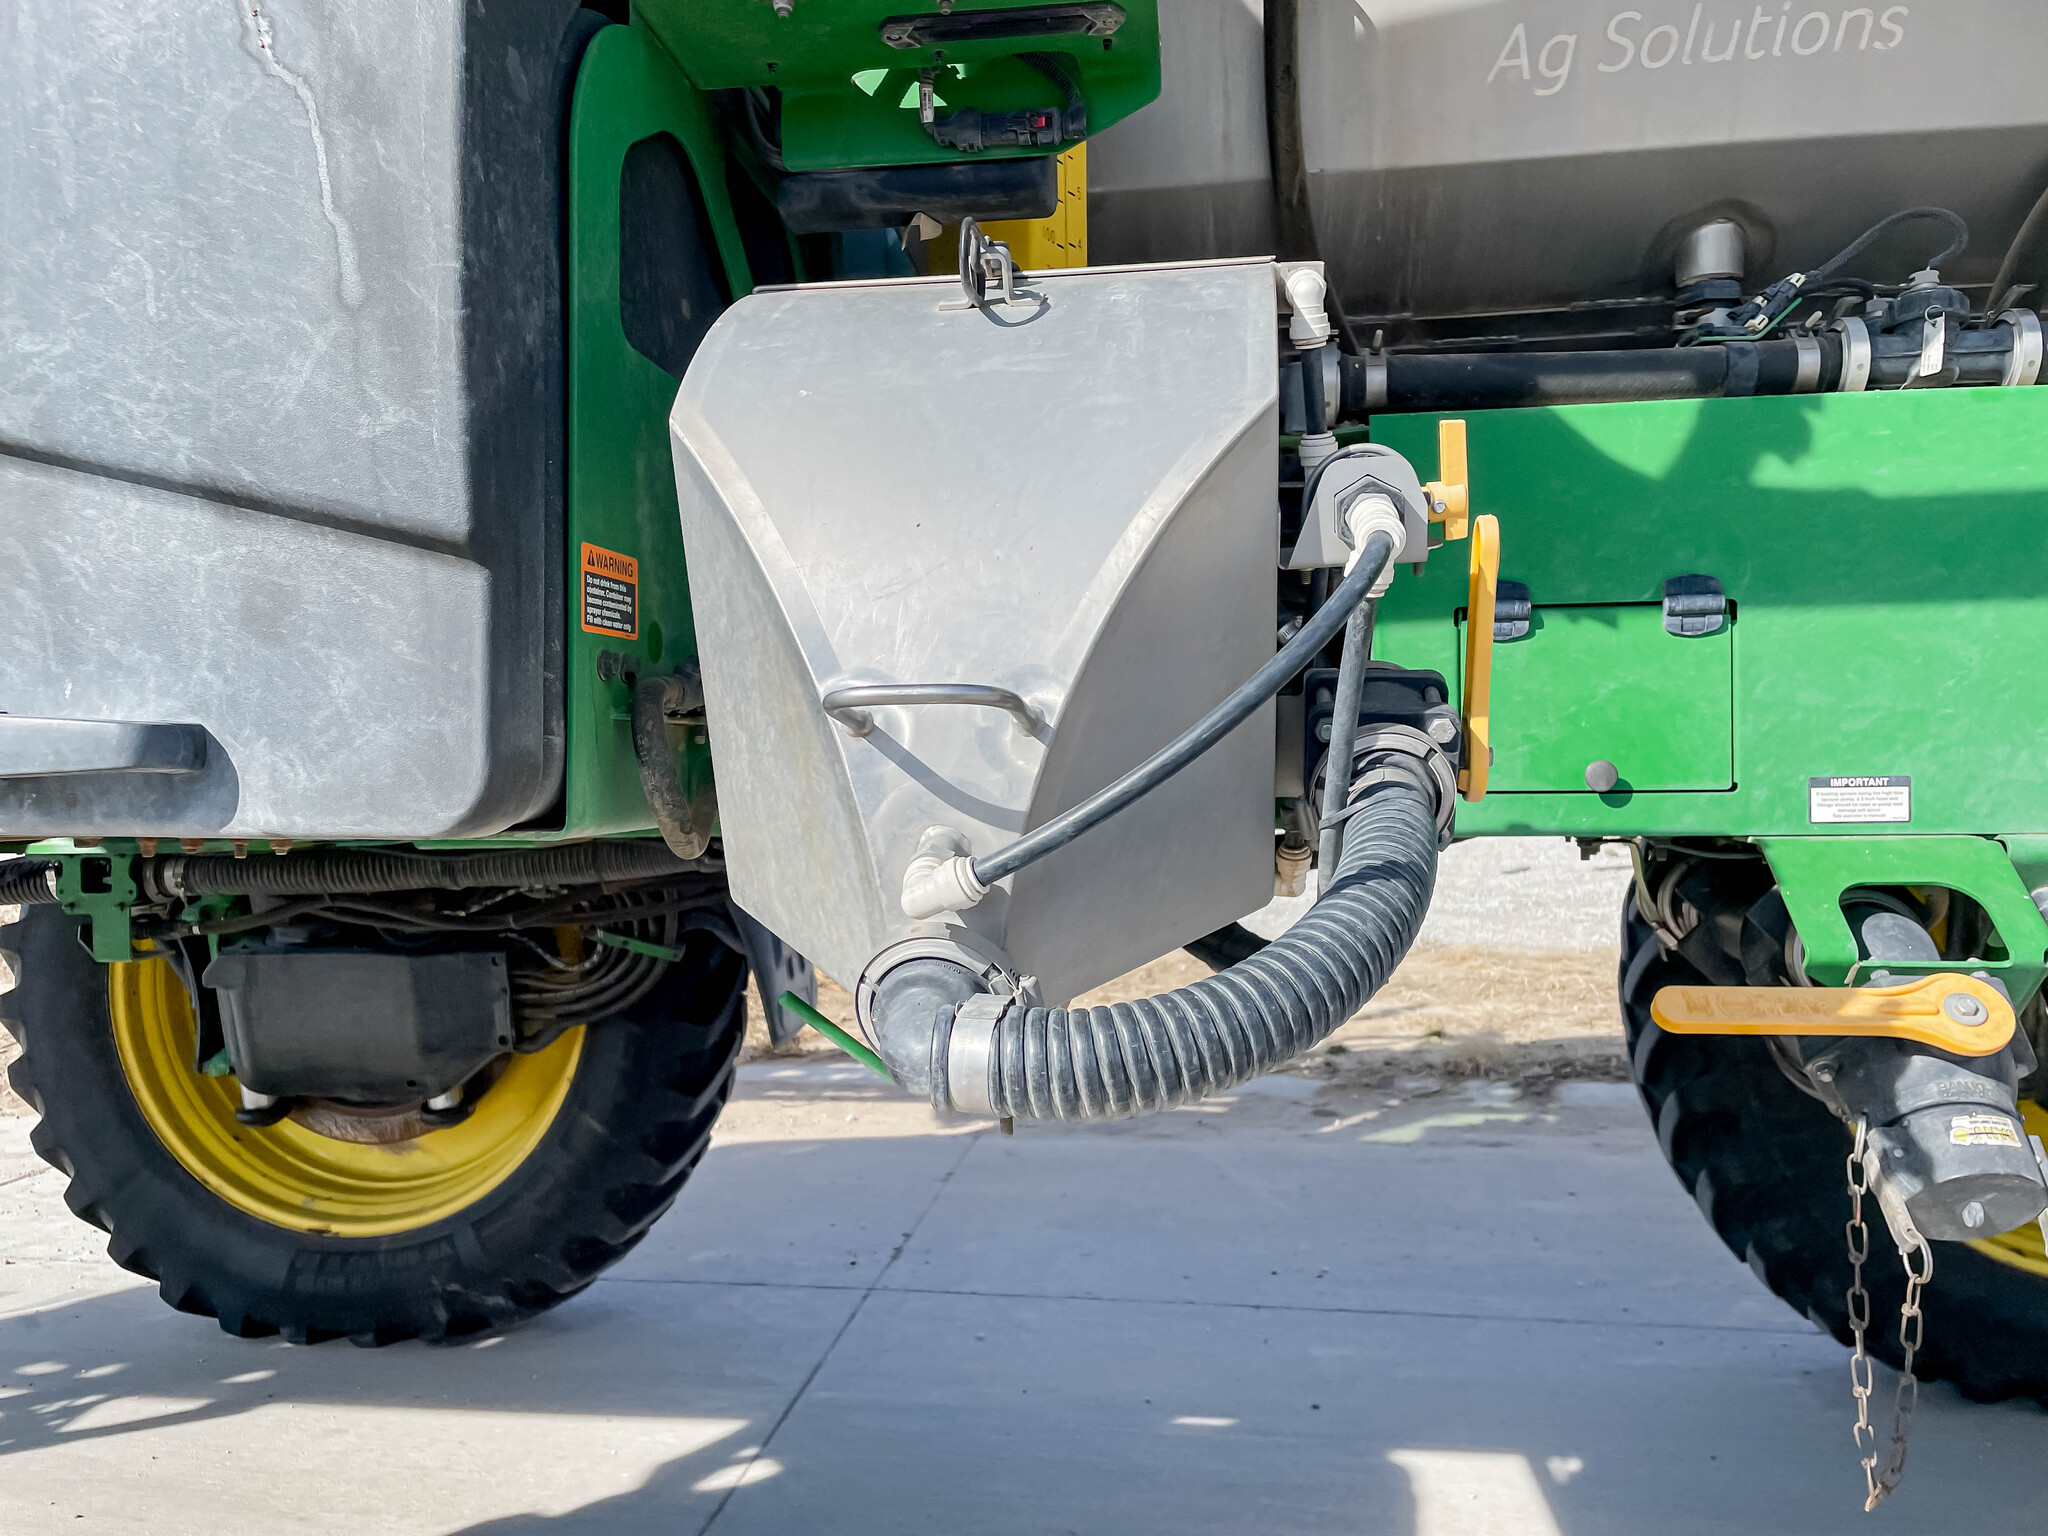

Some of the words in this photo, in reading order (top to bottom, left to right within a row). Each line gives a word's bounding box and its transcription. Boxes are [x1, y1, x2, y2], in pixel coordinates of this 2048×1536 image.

[1485, 22, 1578, 97] Ag
[1597, 0, 1910, 73] Solutions
[596, 553, 633, 577] WARNING
[586, 575, 593, 584] Do
[600, 579, 610, 588] drink
[610, 581, 619, 590] from
[619, 584, 627, 593] this
[605, 589, 624, 601] Container
[586, 594, 602, 606] become
[602, 600, 627, 612] contaminated
[586, 606, 602, 616] sprayer
[593, 616, 602, 625] with
[602, 618, 613, 627] clean
[612, 621, 623, 629] water
[1830, 777, 1890, 788] IMPORTANT
